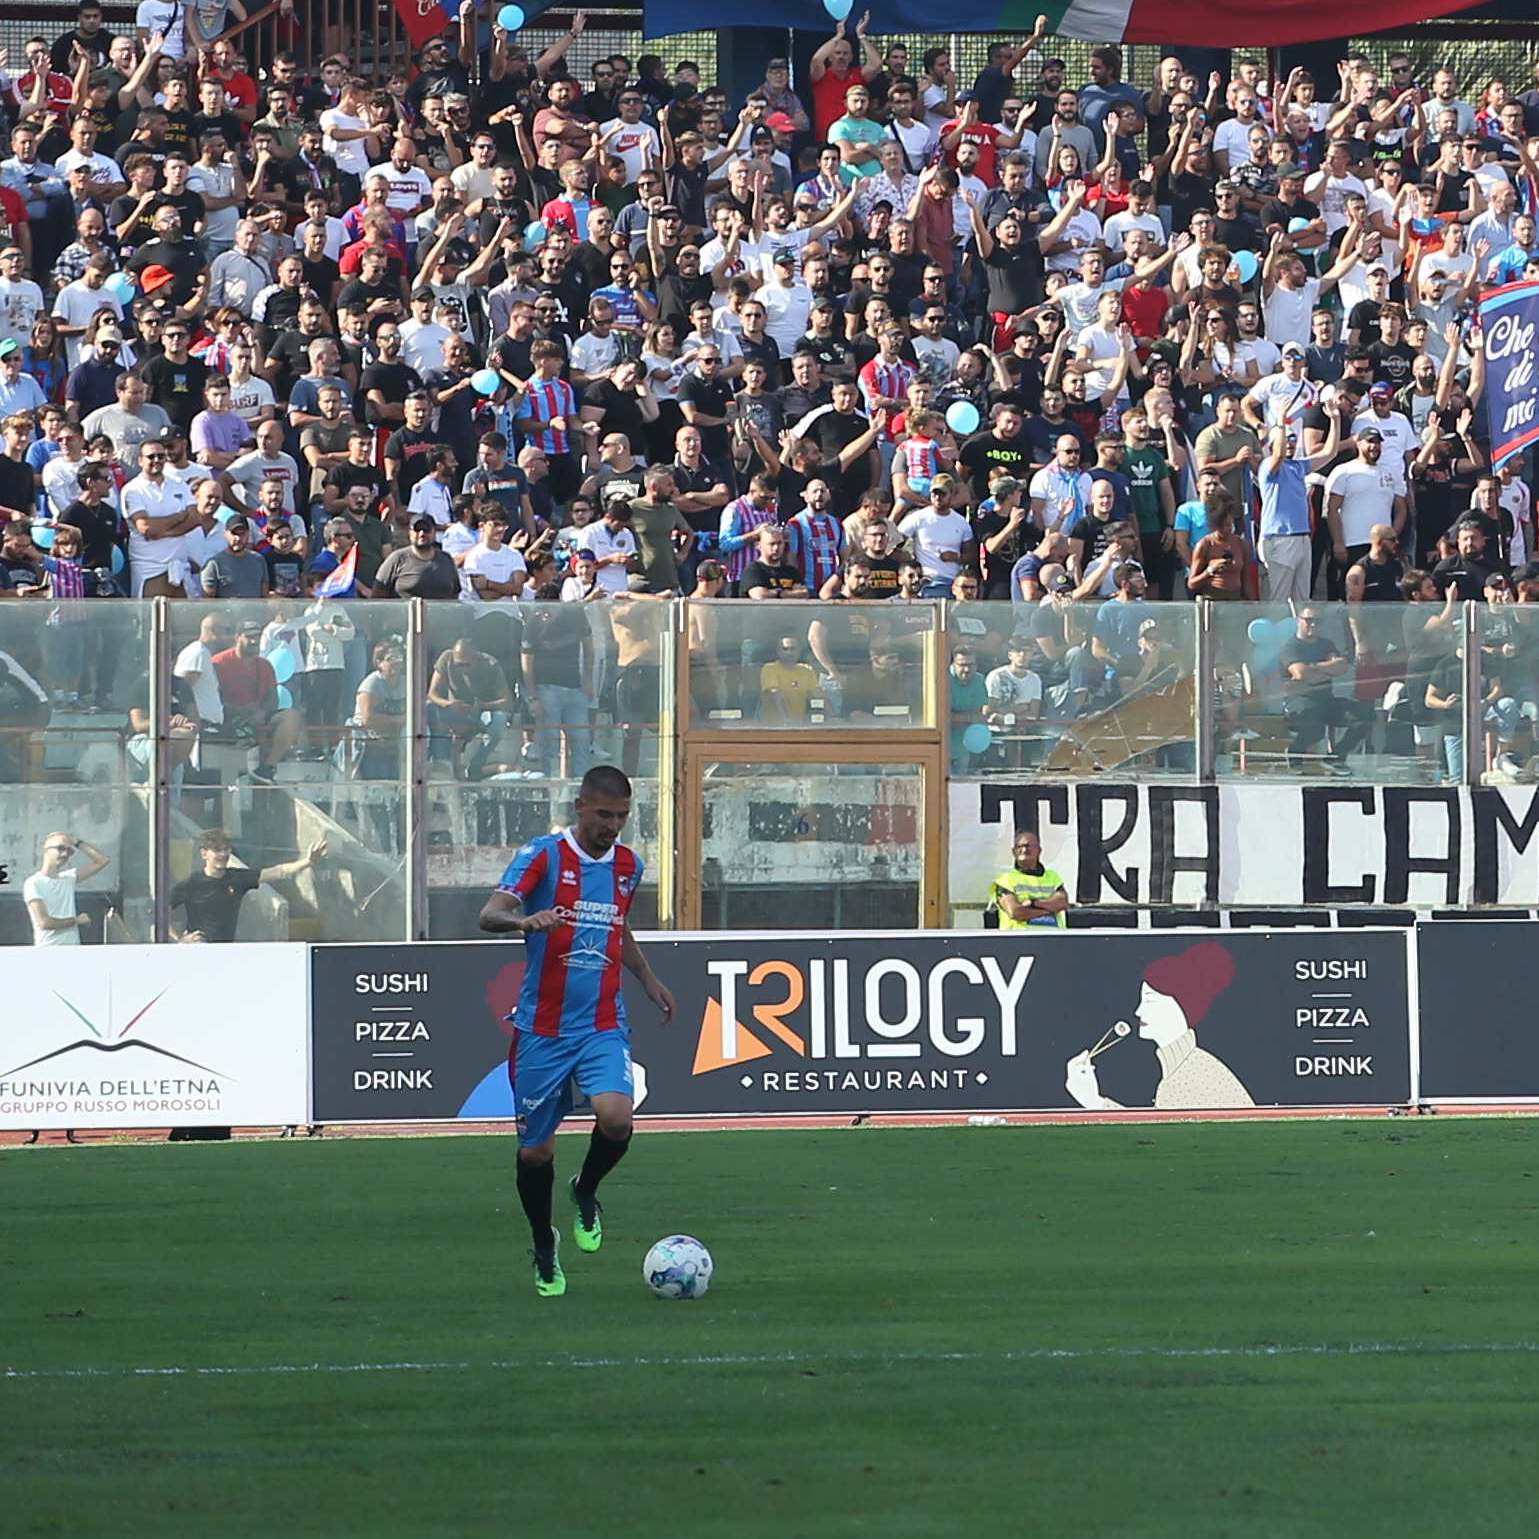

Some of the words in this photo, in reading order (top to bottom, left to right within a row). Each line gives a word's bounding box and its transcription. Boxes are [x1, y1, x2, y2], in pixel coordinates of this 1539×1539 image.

[1485, 314, 1536, 361] Che
[1504, 349, 1535, 393] di
[1502, 387, 1538, 433] mi
[981, 783, 1220, 904] TRA
[1294, 959, 1368, 982] SUSHI
[354, 973, 429, 995] SUSHI
[706, 956, 1035, 1059] TRILOGY
[1295, 1007, 1370, 1030] PIZZA
[355, 1020, 430, 1043] PIZZA
[1294, 1055, 1373, 1077] DRINK
[0, 1080, 92, 1098] FUNIVIA
[99, 1078, 221, 1097] DELL'ETNA
[353, 1068, 433, 1092] DRINK
[762, 1068, 968, 1092] RESTAURANT
[0, 1101, 70, 1115] GRUPPO
[73, 1100, 128, 1114] RUSSO
[133, 1098, 221, 1112] MOROSOLI
